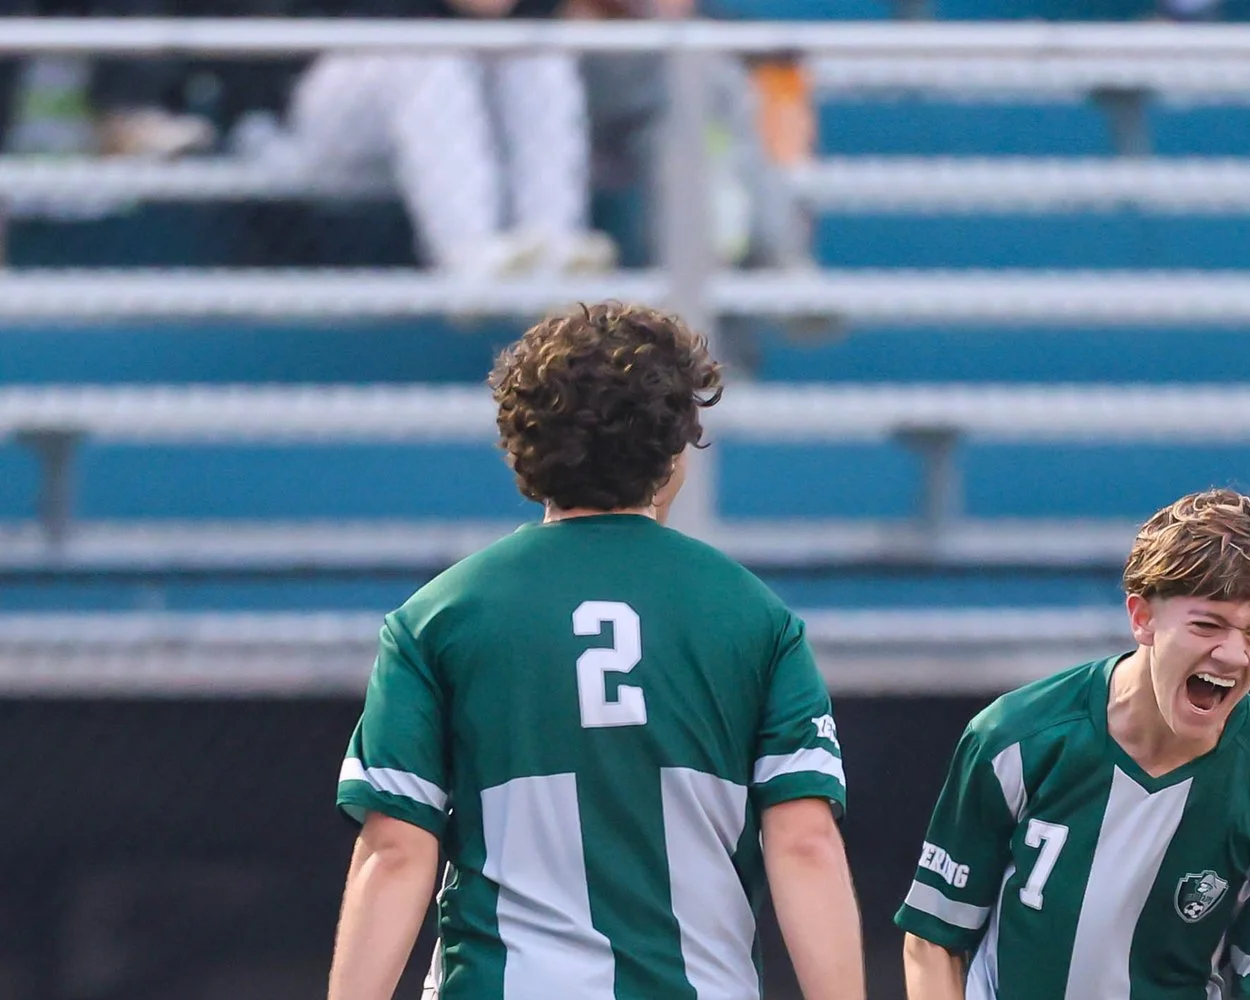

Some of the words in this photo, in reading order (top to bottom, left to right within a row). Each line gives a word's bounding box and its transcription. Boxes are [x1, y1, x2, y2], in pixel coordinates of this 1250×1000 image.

[572, 600, 648, 728] 2
[918, 840, 970, 889] ERING
[1019, 818, 1069, 911] 7
